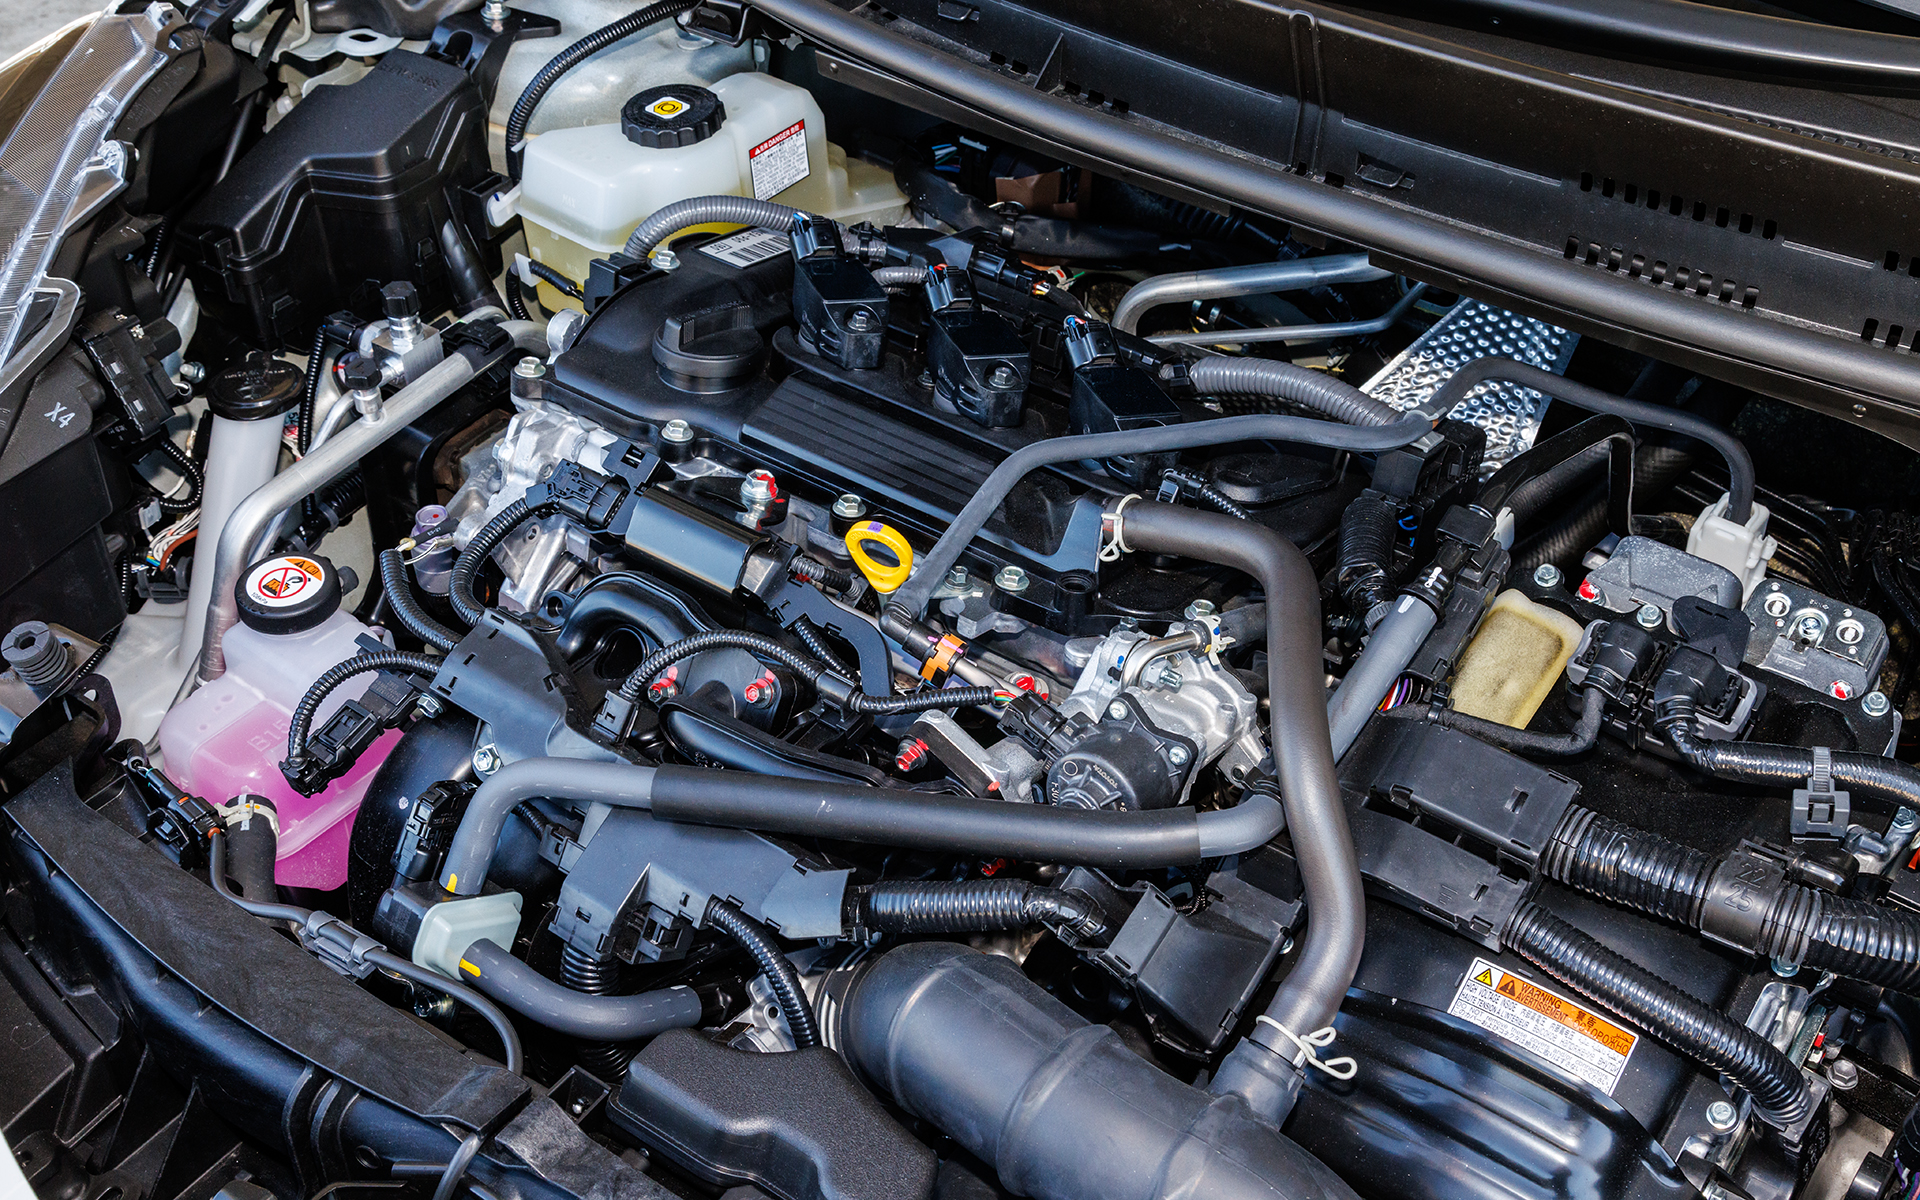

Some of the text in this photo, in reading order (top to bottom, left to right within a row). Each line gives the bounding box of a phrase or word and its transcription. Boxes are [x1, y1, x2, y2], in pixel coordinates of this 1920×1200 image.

[768, 129, 790, 147] DANGER
[43, 401, 76, 429] X4
[1093, 764, 1119, 789] TOYOTA
[1734, 862, 1766, 888] 22
[1723, 882, 1760, 912] 25
[1464, 981, 1478, 993] HIGH
[1477, 987, 1501, 1004] VOLTAGE
[1499, 997, 1518, 1012] INSIDE
[1476, 997, 1498, 1014] TENSION
[1520, 983, 1562, 1009] WARNING
[1468, 1006, 1483, 1017] NOT
[1515, 991, 1630, 1053] AVERTISSEMENT ОСТОРОЖНО
